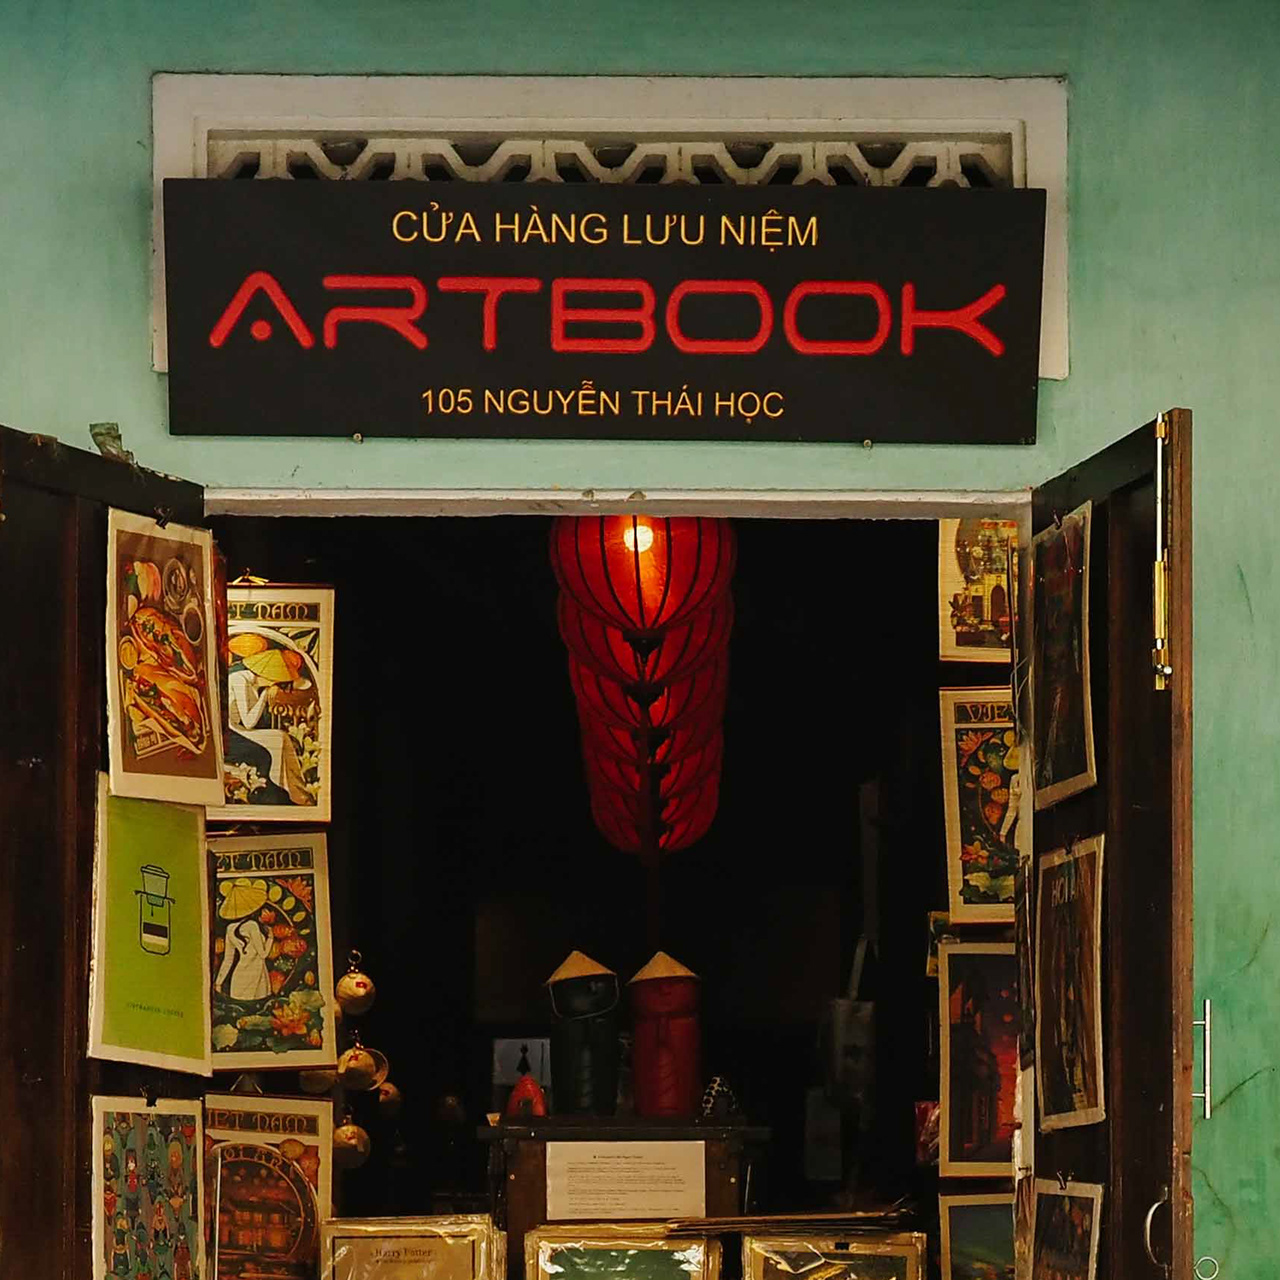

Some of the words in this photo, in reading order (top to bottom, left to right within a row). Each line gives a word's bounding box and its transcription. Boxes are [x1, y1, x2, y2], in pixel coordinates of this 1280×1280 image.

[392, 201, 481, 244] CỬA
[495, 205, 608, 244] HÀNG
[623, 213, 705, 245] LƯU
[720, 209, 817, 252] NIỆM
[209, 271, 1007, 357] ARTBOOK
[422, 388, 473, 414] 105
[484, 379, 619, 416] NGUYỄN
[631, 385, 702, 416] THÁI
[715, 391, 785, 423] HỌC
[253, 602, 308, 620] NAM
[252, 1113, 307, 1134] NAM
